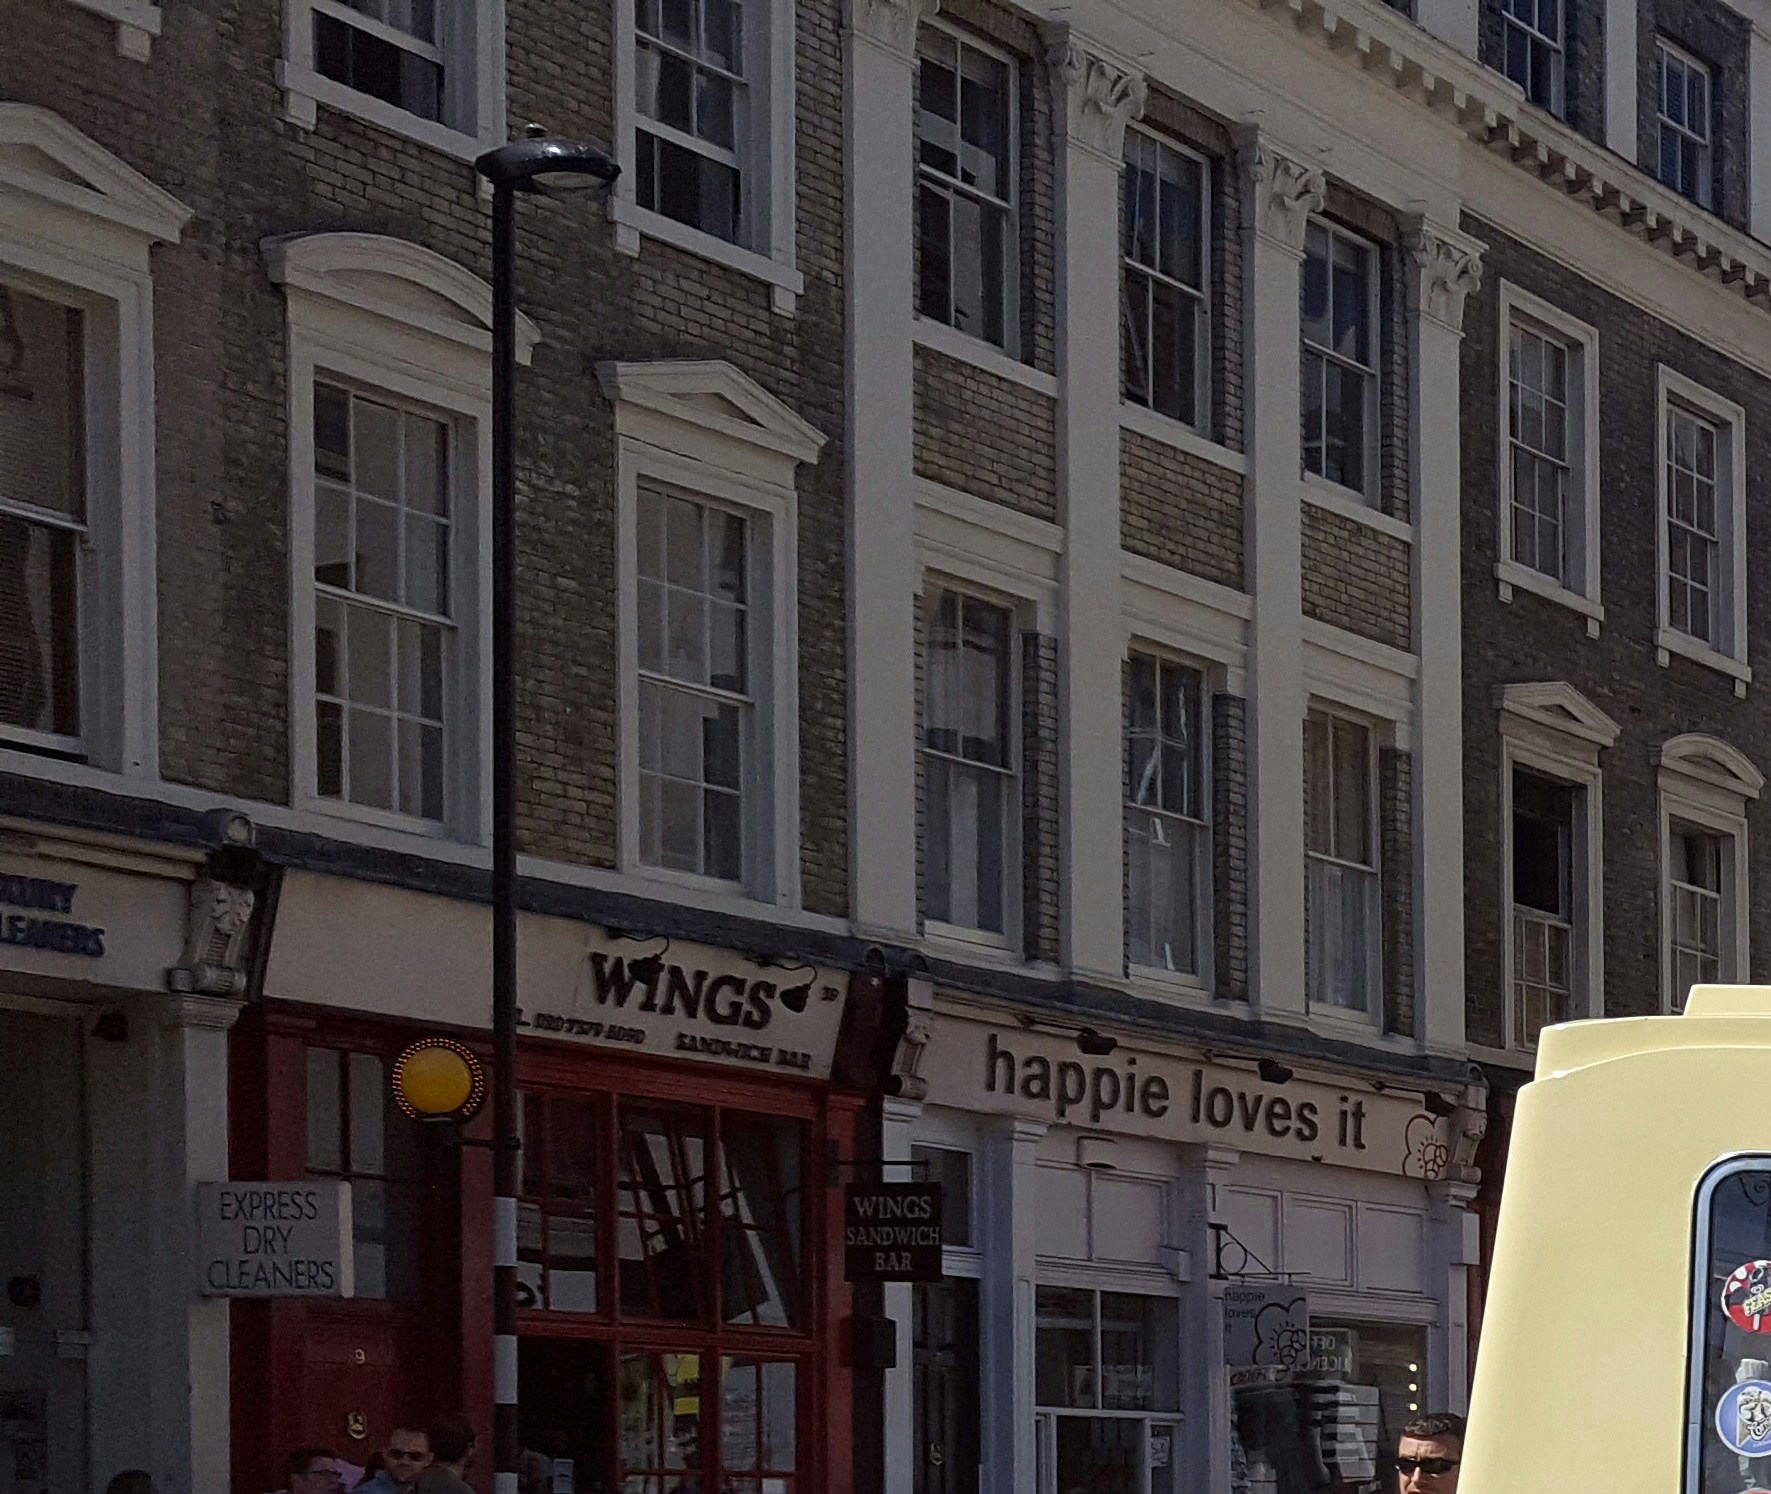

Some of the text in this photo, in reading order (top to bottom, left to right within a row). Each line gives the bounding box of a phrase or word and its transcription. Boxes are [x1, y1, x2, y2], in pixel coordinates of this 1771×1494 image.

[591, 952, 778, 1031] WINGS
[676, 1032, 812, 1070] SANDWICH BAR
[984, 1033, 1367, 1151] happie loves it
[220, 1191, 318, 1221] EXPRESS
[852, 1194, 932, 1219] WINGS
[243, 1226, 294, 1255] DRY
[846, 1226, 941, 1246] SANDWICH
[207, 1259, 334, 1290] CLEANERS
[874, 1251, 913, 1272] BAR
[353, 1348, 366, 1365] 9
